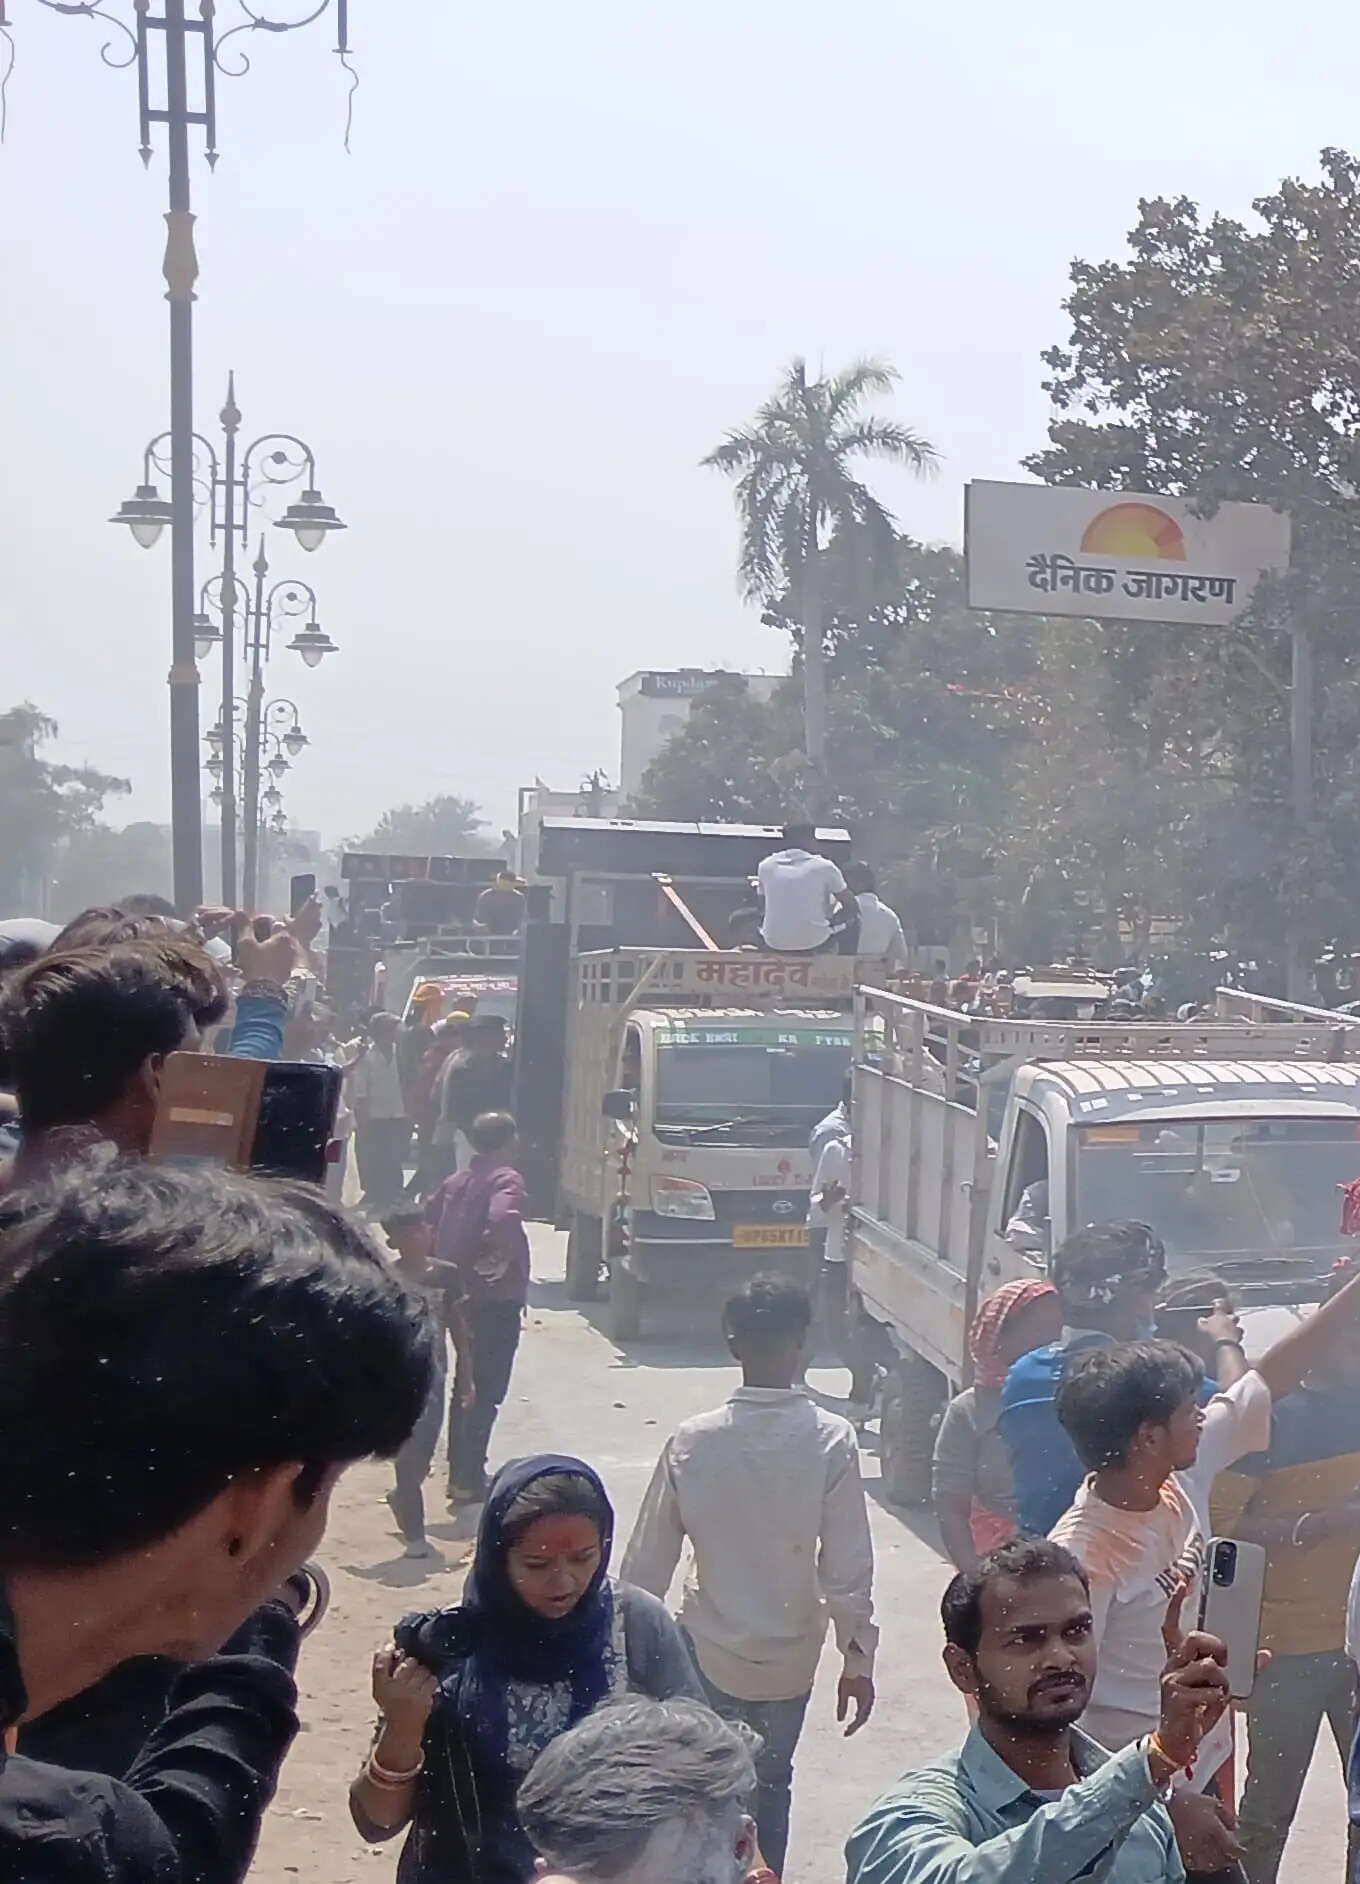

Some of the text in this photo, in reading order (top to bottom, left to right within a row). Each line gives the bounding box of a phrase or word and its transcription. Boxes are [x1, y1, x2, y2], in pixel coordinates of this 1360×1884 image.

[1025, 554, 1237, 604] दैनिक जागरण
[696, 959, 813, 993] महादेव
